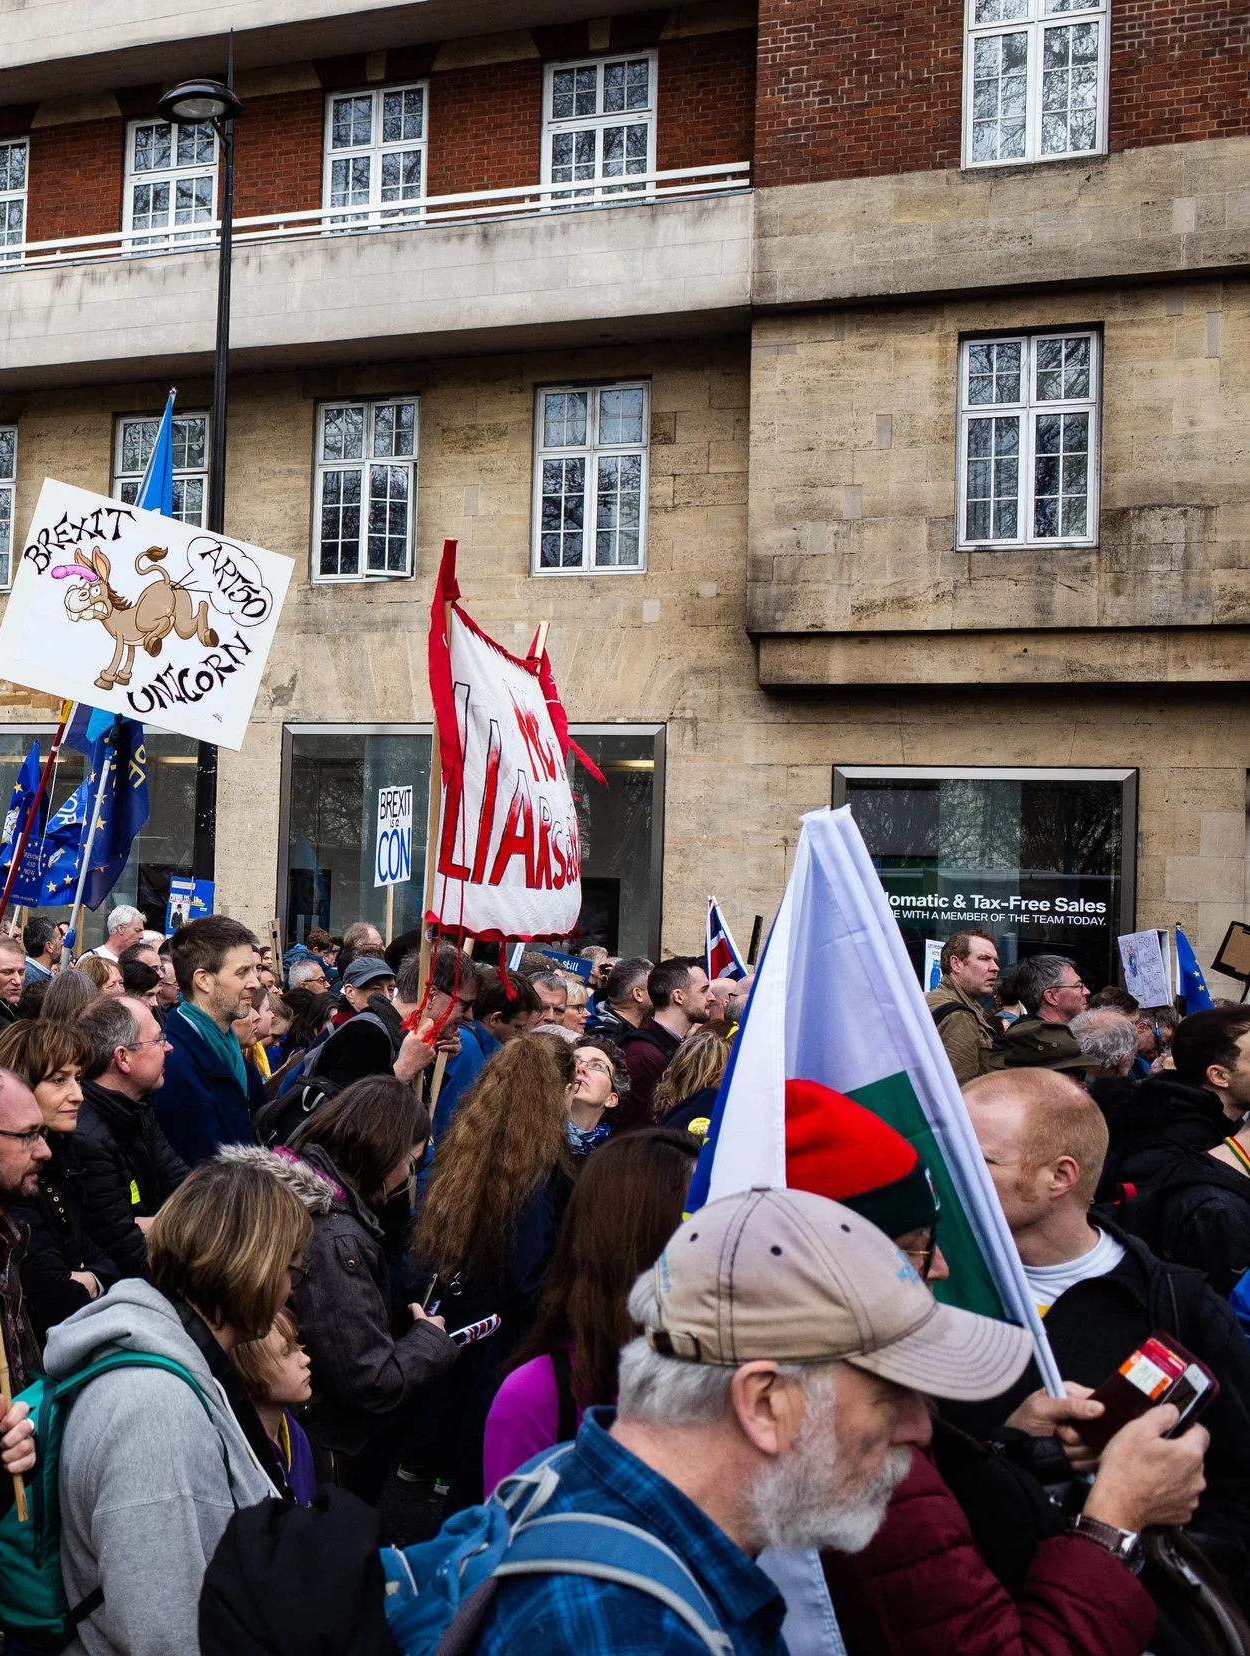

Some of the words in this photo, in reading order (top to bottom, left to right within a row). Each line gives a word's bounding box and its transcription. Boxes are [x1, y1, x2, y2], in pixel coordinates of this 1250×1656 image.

[24, 508, 137, 575] BREXIT
[126, 631, 252, 714] UNICORN
[380, 788, 412, 820] BREXIT
[377, 827, 411, 883] CON
[902, 910, 930, 920] WITH
[931, 911, 940, 920] A
[940, 911, 988, 922] MEMBER
[990, 913, 1006, 923] OF
[1008, 914, 1030, 923] THE
[1032, 914, 1065, 925] TEAM
[1066, 916, 1107, 926] TODAY.
[953, 894, 967, 909] &
[970, 894, 1051, 912] Tax-Free
[1054, 897, 1107, 913] Sales
